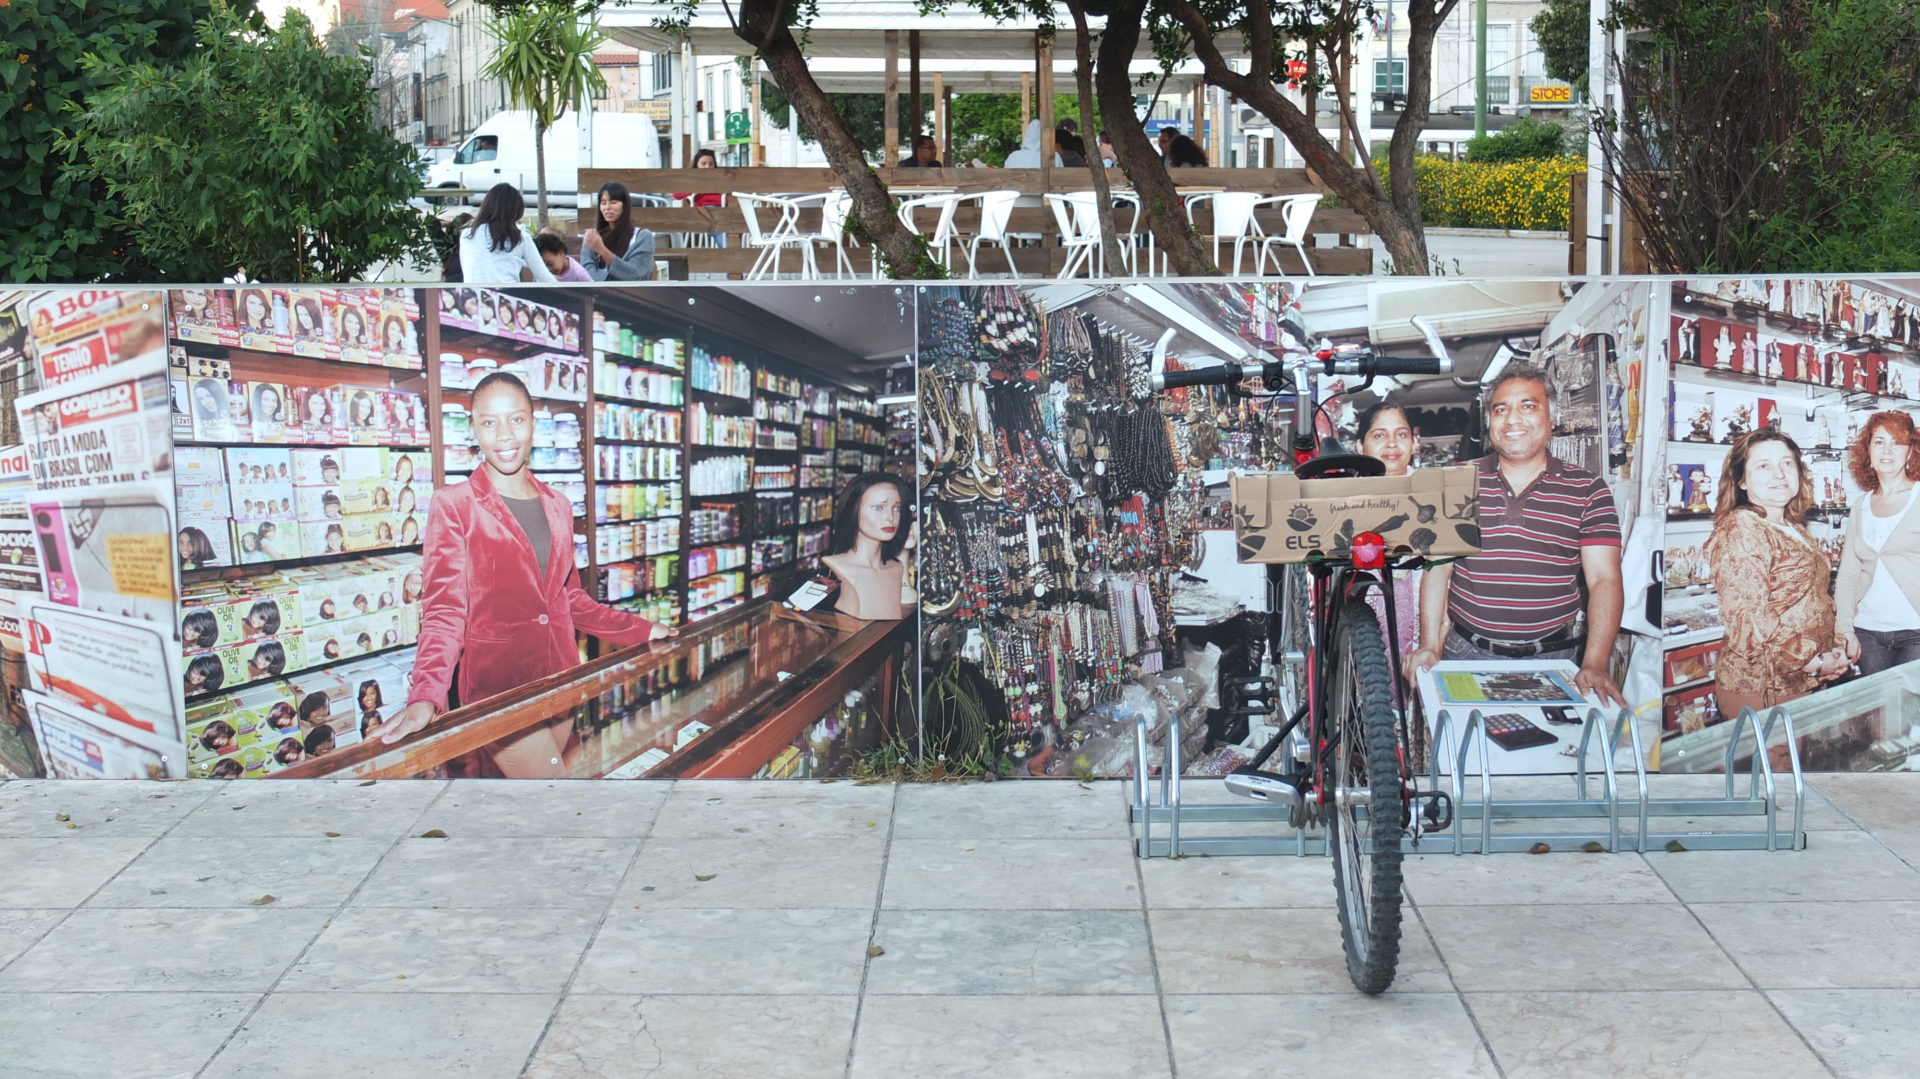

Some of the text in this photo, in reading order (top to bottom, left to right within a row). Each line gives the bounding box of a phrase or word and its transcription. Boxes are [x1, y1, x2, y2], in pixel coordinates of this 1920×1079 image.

[1531, 87, 1570, 100] STOPE
[72, 428, 107, 453] MODA
[48, 458, 82, 478] BRASIL
[85, 452, 113, 474] COM
[1351, 500, 1365, 509] and
[1286, 535, 1321, 549] ELS
[217, 605, 235, 615] OLIVE
[222, 614, 234, 622] OIL
[28, 619, 52, 657] P
[222, 648, 240, 658] OLIVE
[228, 656, 240, 664] OIL
